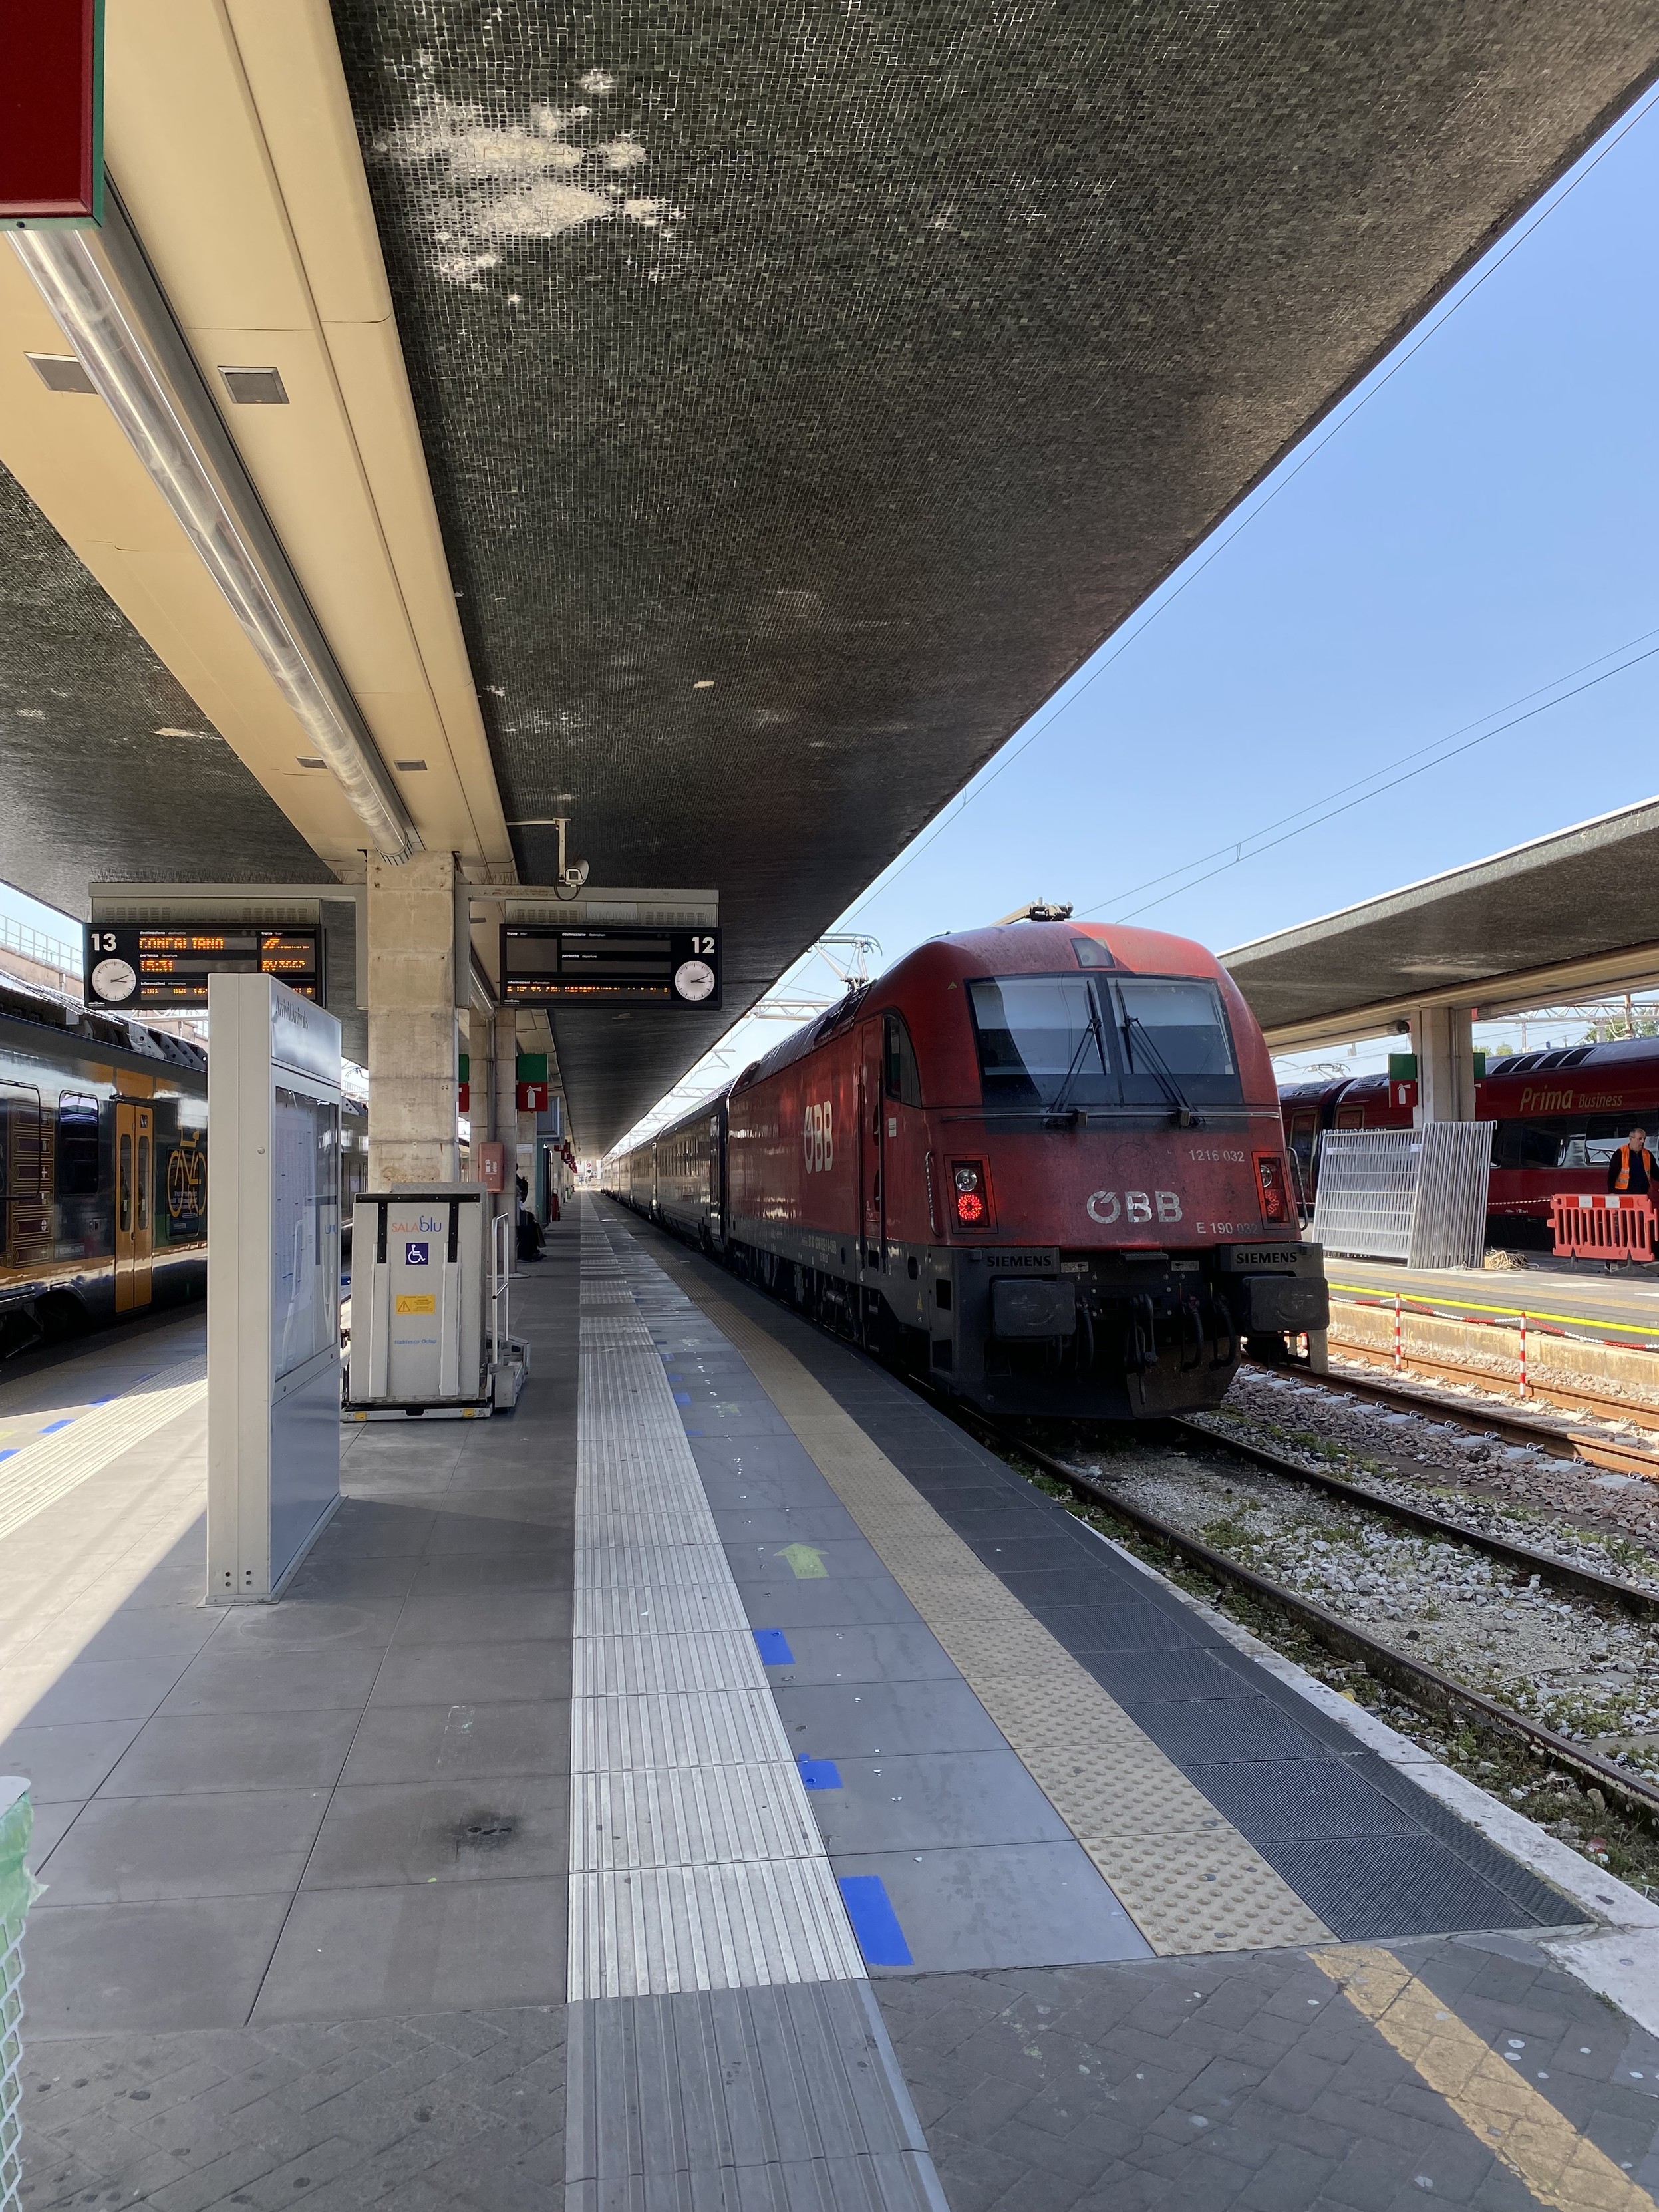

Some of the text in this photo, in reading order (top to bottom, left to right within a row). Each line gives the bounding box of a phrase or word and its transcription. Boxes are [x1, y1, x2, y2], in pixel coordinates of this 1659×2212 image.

[90, 933, 117, 951] 13
[691, 936, 715, 953] 12
[1519, 1084, 1624, 1112] Prima Business
[804, 1100, 833, 1174] ÖBB
[1189, 1150, 1245, 1162] 1216 032
[1086, 1191, 1183, 1224] ÖBB
[1196, 1222, 1259, 1234] E 190 032
[987, 1255, 1051, 1267] SIEMENS
[1236, 1251, 1298, 1264] SIEMENS
